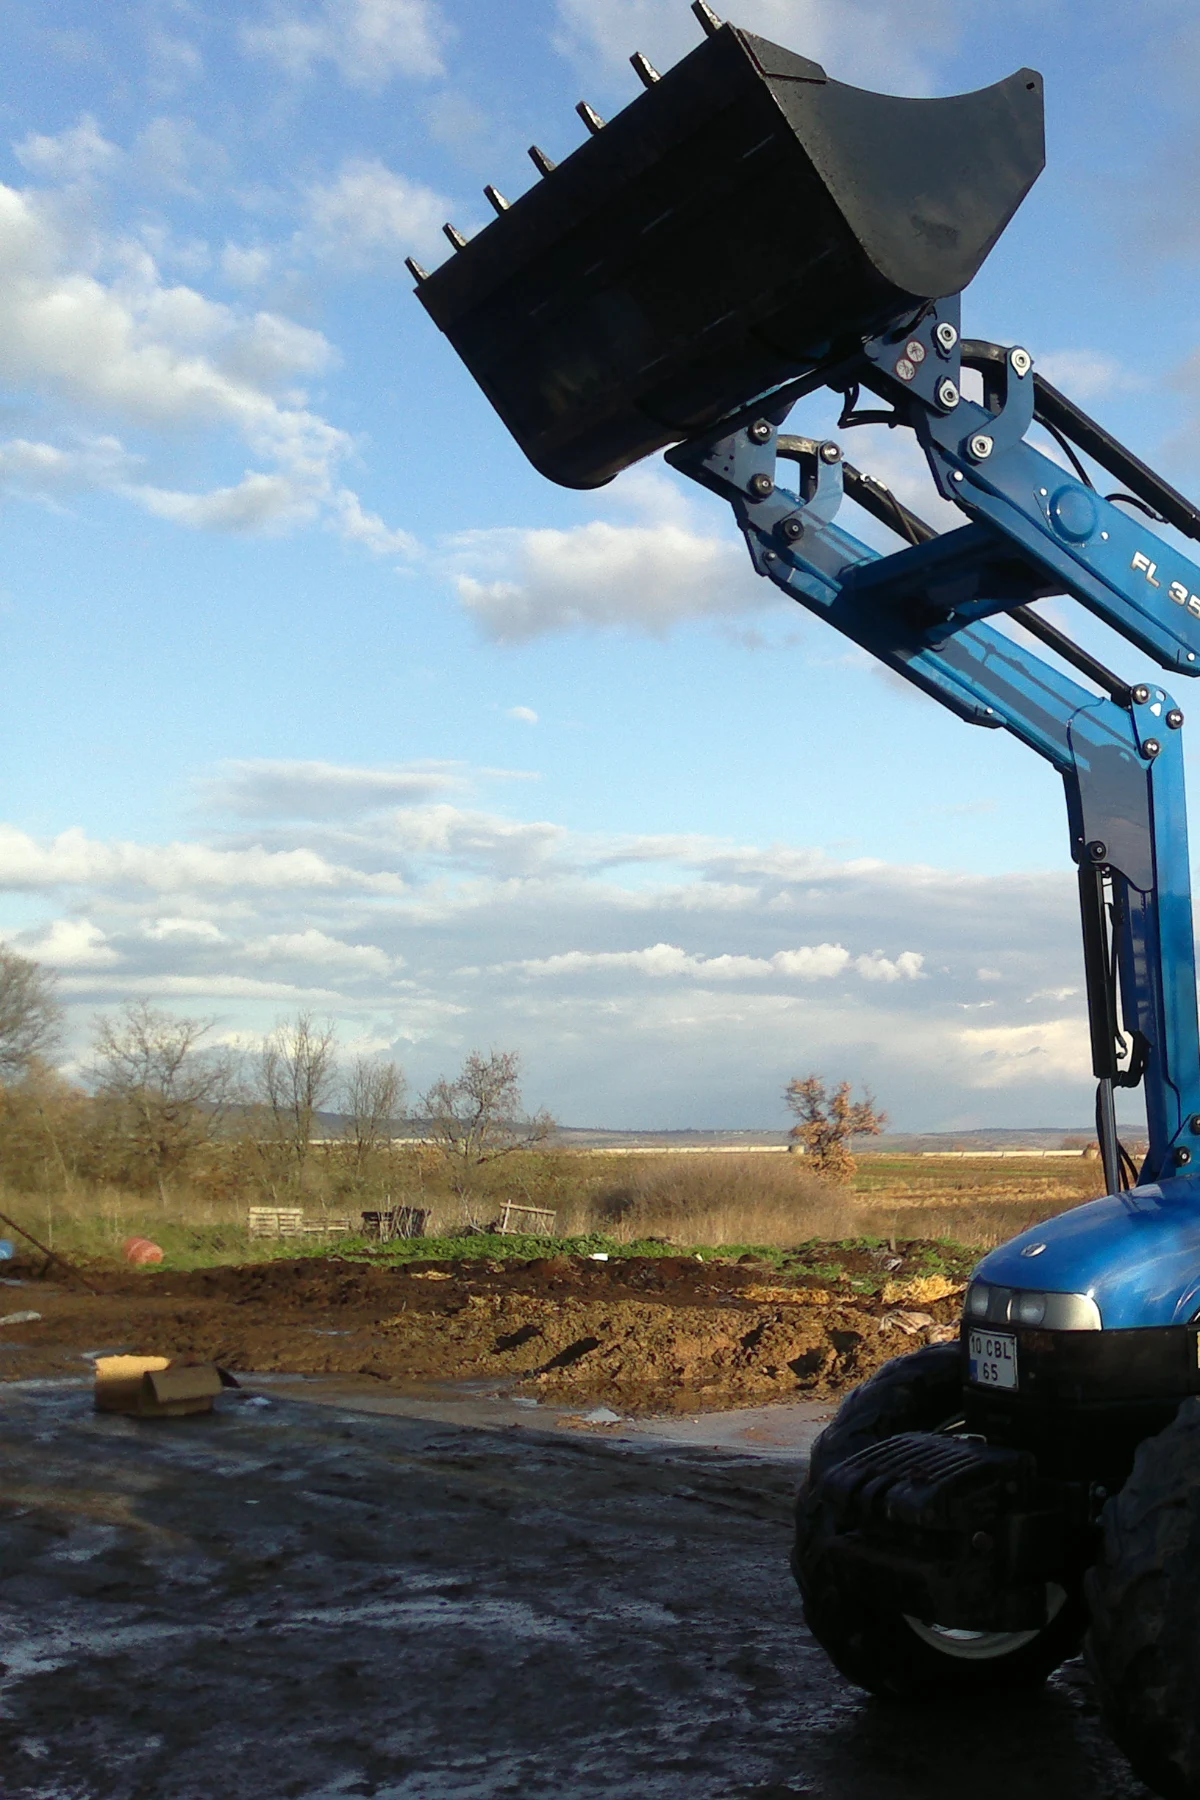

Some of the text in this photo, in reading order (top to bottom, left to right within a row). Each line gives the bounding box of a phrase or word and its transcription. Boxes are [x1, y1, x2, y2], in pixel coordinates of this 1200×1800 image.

[1130, 551, 1160, 589] FL
[971, 1335, 1012, 1360] 10 CBL
[983, 1362, 999, 1382] 65
